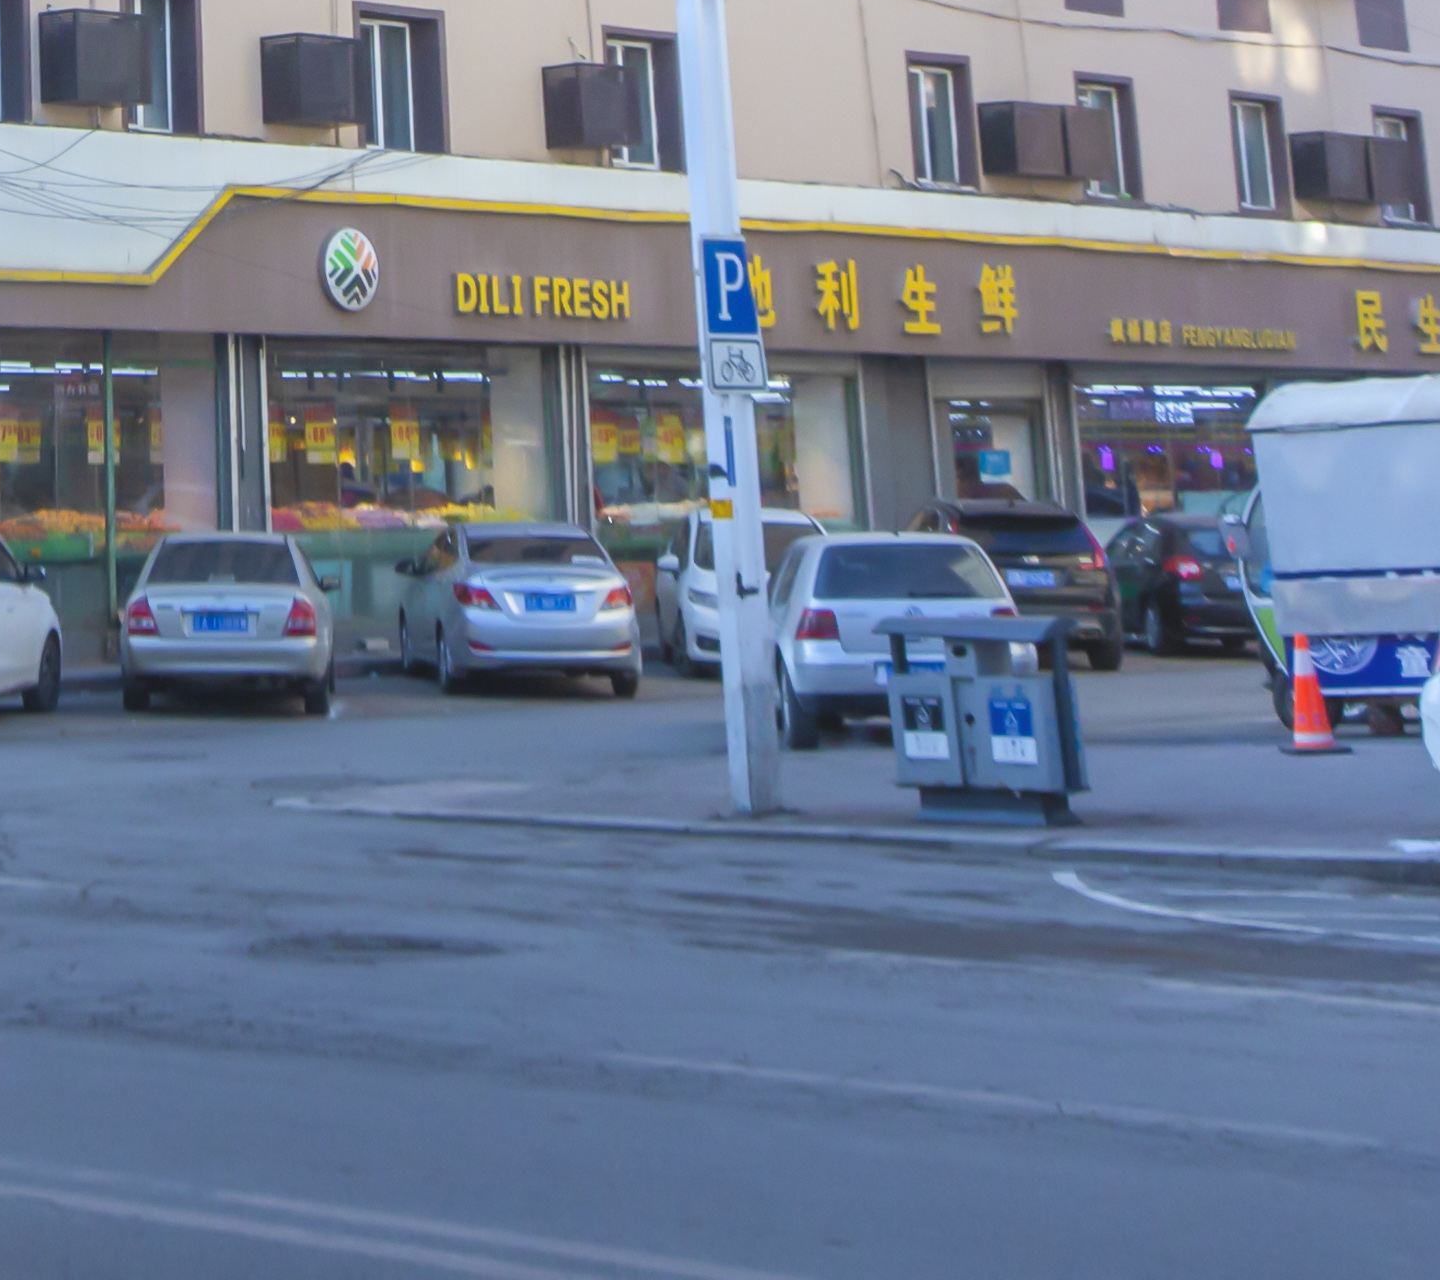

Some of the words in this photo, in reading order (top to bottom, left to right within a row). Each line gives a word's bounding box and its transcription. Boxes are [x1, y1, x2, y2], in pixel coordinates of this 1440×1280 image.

[456, 273, 523, 316] DILI
[533, 276, 631, 320] FRESH
[715, 252, 744, 321] P
